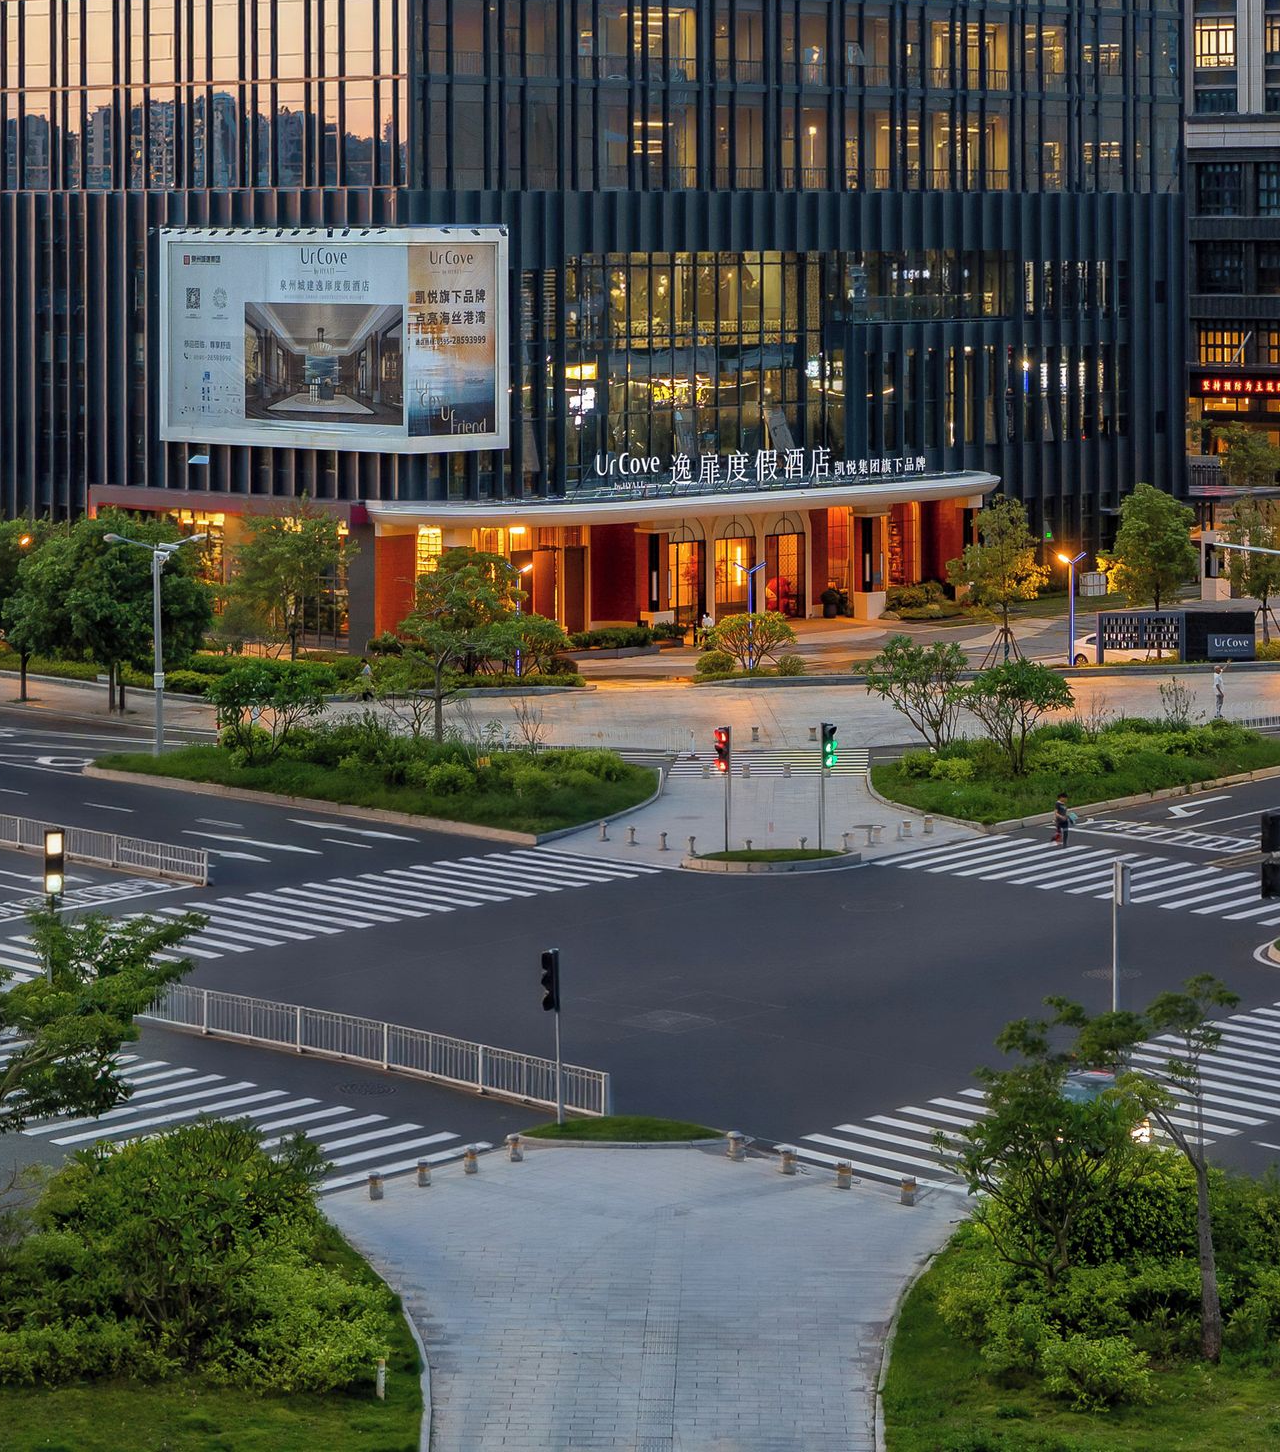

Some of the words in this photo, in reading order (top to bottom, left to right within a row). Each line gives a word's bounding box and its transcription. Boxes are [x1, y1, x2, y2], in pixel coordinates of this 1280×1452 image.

[300, 247, 348, 265] UrCove
[429, 250, 474, 265] UrCove
[415, 289, 486, 304] 凯悦旗下品牌
[415, 310, 486, 325] 点亮海丝港湾
[451, 418, 486, 435] Friend
[596, 452, 660, 476] UrCove
[669, 445, 831, 485] 逸扉度假酒店
[834, 455, 926, 477] 凯悦集团旗下品牌
[1214, 637, 1249, 647] UrCove
